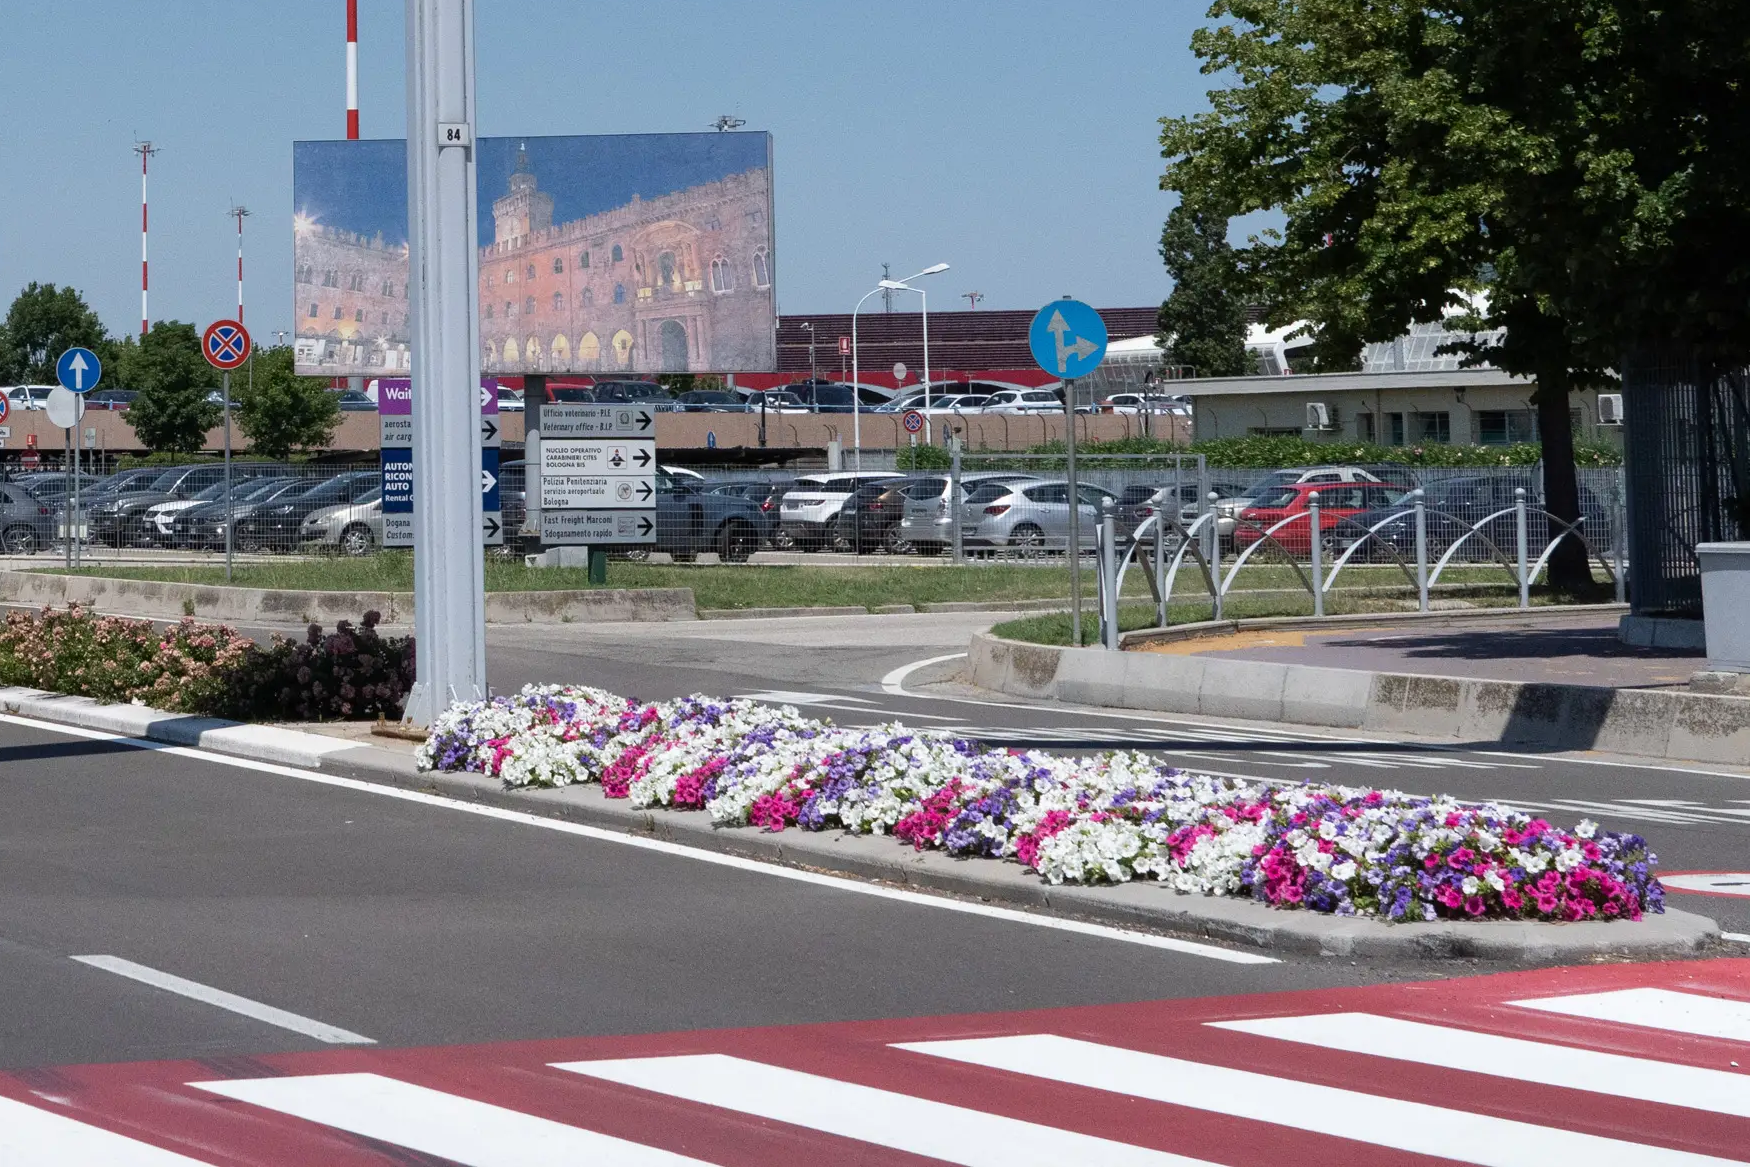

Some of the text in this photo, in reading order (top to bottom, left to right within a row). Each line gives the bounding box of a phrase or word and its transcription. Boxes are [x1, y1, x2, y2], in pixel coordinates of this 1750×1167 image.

[447, 128, 461, 141] 84
[543, 409, 563, 418] Ufficio
[565, 409, 596, 418] veterinario
[575, 423, 594, 431] office
[384, 432, 394, 441] air
[385, 472, 413, 481] RICON
[543, 477, 608, 486] Polizia Penitenziaria
[384, 482, 409, 491] AUTO
[544, 487, 605, 496] servizio aeroportuale
[385, 494, 408, 502] Rental
[543, 497, 569, 507] Bologna
[386, 518, 410, 528] Dogana
[544, 515, 613, 526] Fast Freight Marconi
[544, 529, 613, 539] Sdoganamento rapido
